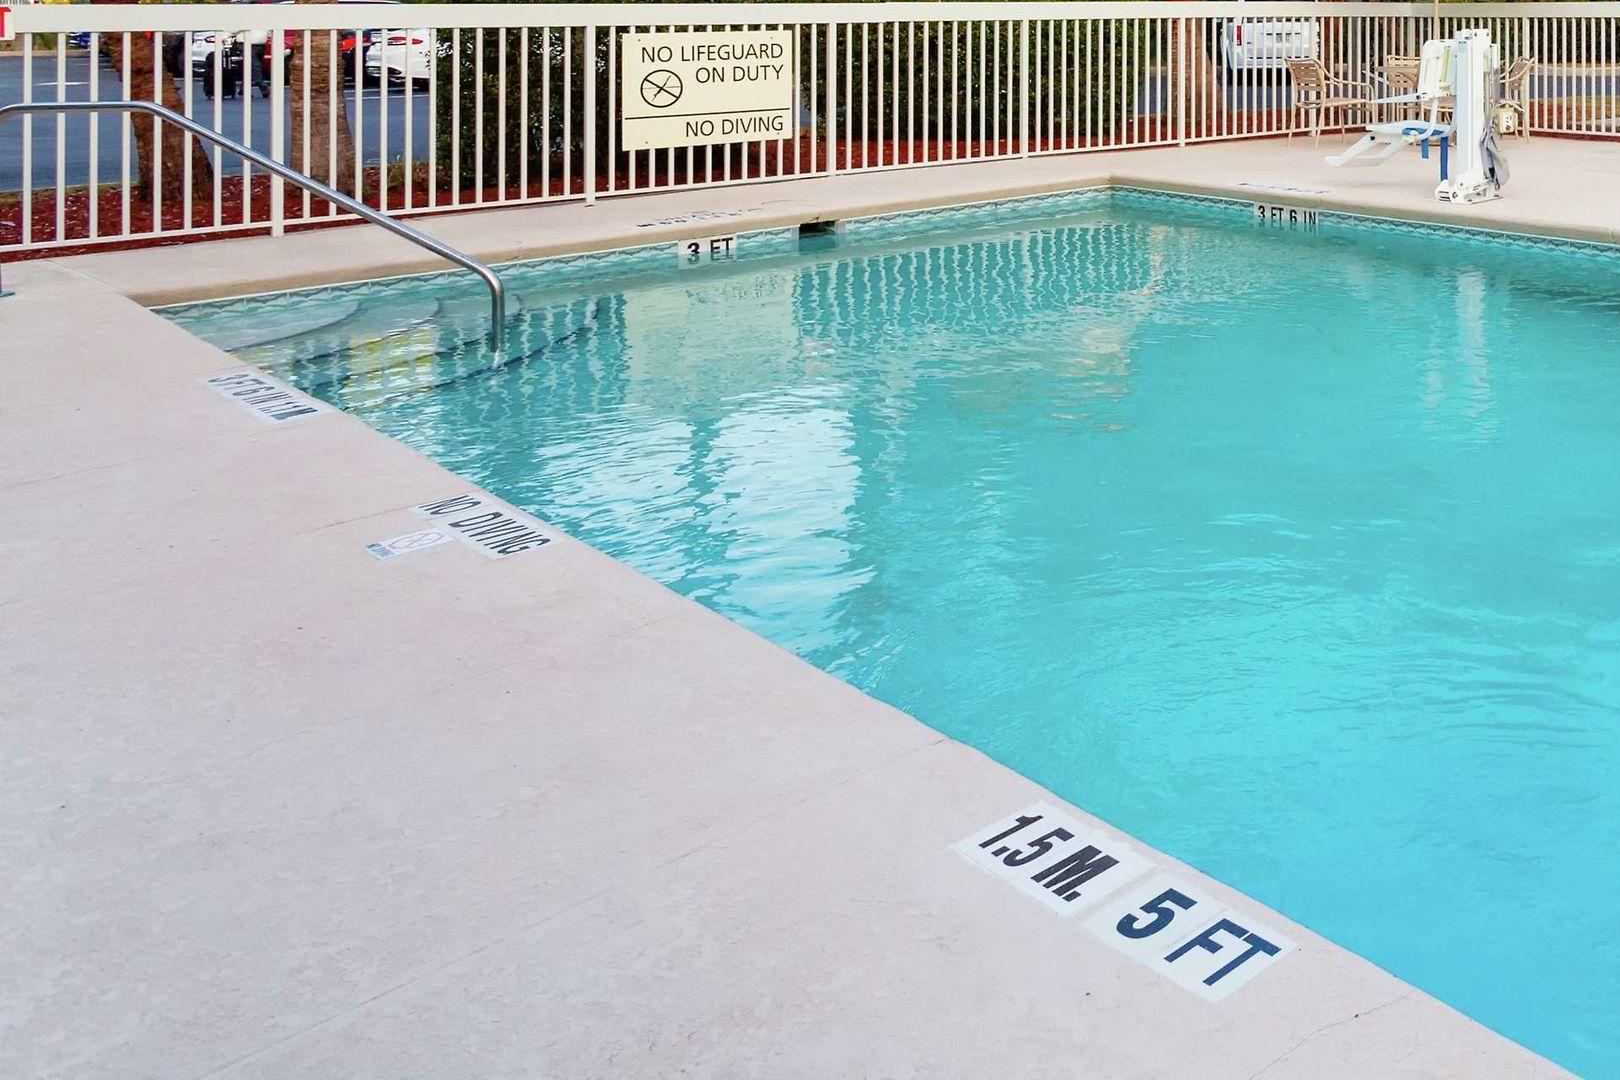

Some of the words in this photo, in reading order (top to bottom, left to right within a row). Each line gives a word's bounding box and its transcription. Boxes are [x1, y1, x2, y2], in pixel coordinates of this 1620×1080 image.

[641, 46, 673, 63] NO
[681, 43, 783, 62] LIFEGUARD
[695, 67, 725, 83] ON
[733, 64, 784, 82] DUTY
[685, 120, 714, 137] NO
[721, 115, 784, 135] DIVING
[1258, 205, 1266, 219] 3
[1271, 207, 1284, 220] FT
[1290, 209, 1298, 223] 6
[1303, 210, 1316, 224] IN
[687, 242, 700, 255] 3
[710, 237, 733, 253] FT
[418, 495, 482, 515] NO
[448, 511, 551, 556] DIVING
[978, 814, 1075, 867] 1.5
[1030, 844, 1120, 903] M.
[1116, 888, 1198, 940] 5
[1163, 918, 1282, 987] FT
